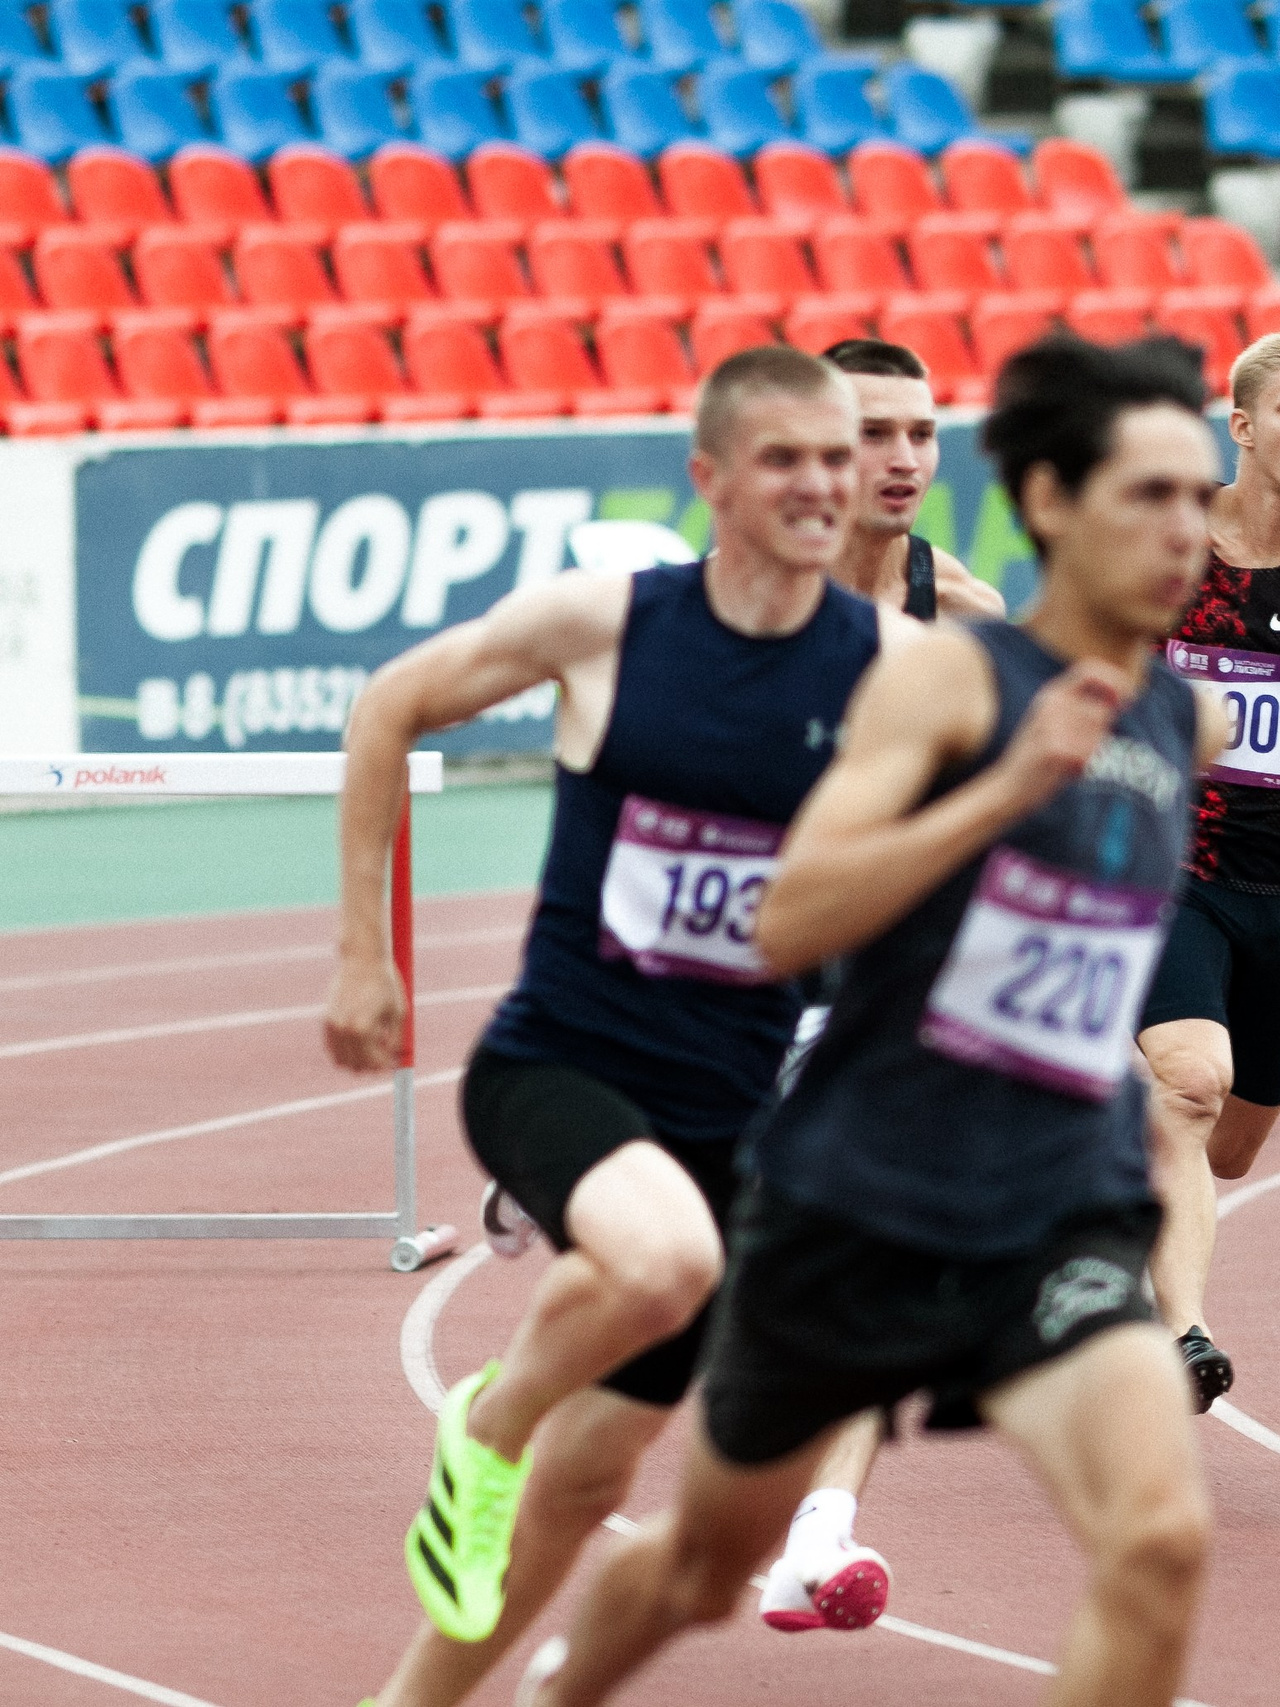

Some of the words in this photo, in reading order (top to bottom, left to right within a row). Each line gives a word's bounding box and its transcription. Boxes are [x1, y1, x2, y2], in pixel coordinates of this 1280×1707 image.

[74, 765, 166, 788] polanik
[661, 863, 767, 945] 193
[992, 934, 1126, 1036] 220
